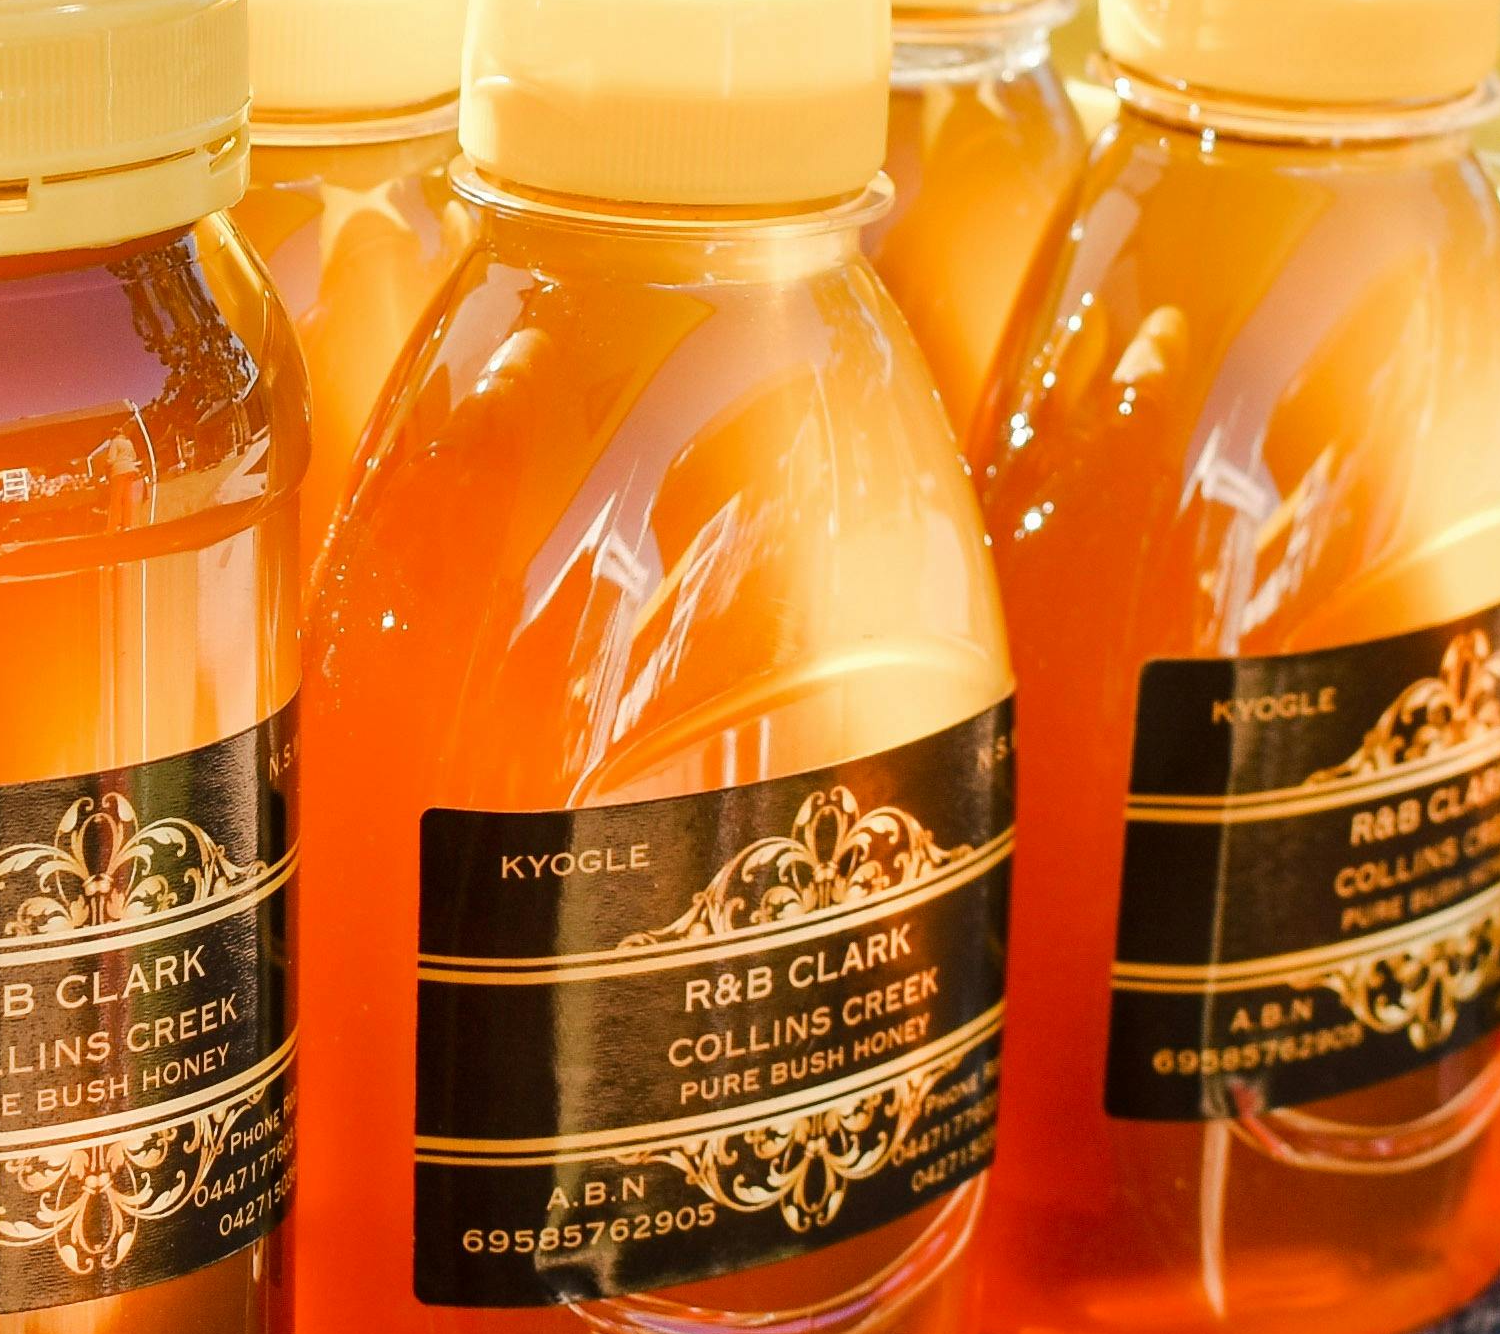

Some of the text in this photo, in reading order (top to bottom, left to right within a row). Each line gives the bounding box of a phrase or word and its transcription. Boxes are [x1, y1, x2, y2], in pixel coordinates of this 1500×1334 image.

[1211, 687, 1337, 724] KYOGLE
[1351, 798, 1421, 847] R&B
[500, 843, 650, 880] KYOGLE
[1334, 836, 1459, 899] COLLINS
[55, 945, 207, 1010] CLARK
[684, 923, 912, 1013] R&B CLARK
[127, 993, 238, 1052] CREEK
[667, 967, 941, 1068] COLLINS CREEK
[36, 1072, 130, 1114] BUSH
[142, 1042, 230, 1092] HONEY
[680, 1012, 931, 1105] PURE BUSH HONEY
[230, 1108, 280, 1155] PHONE
[546, 1175, 646, 1209] A.B.N
[462, 1203, 717, 1254] 69585762905
